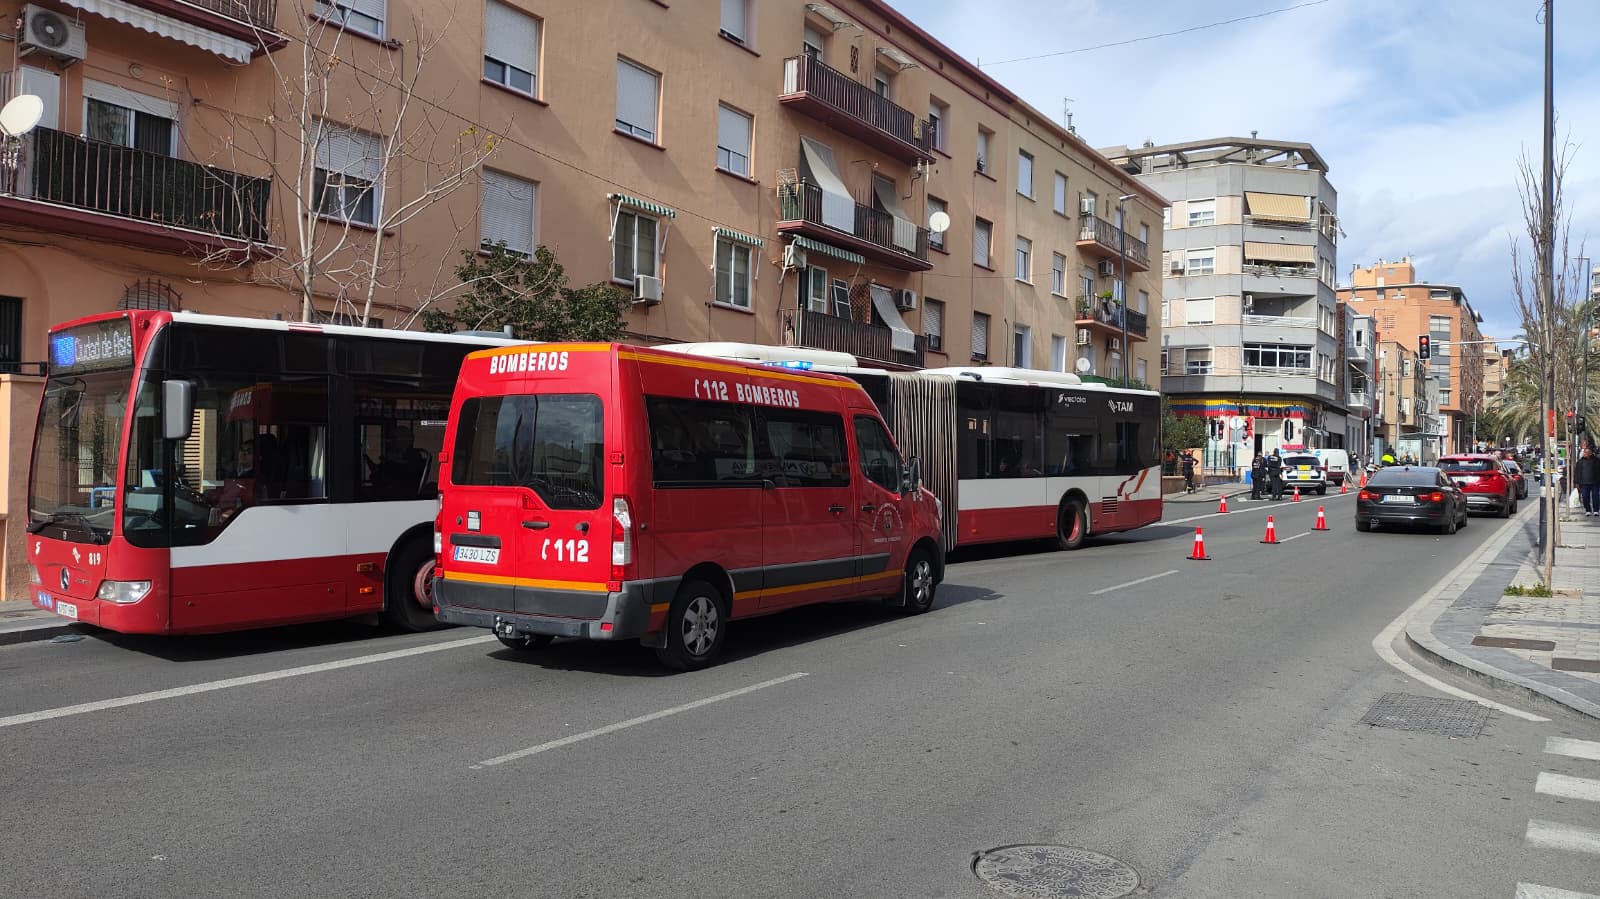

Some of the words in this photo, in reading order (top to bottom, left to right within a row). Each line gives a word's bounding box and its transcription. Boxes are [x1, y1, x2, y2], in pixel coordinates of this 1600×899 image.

[489, 351, 569, 375] BOMBEROS
[702, 379, 729, 401] 112
[735, 382, 800, 408] BOMBEROS
[1116, 401, 1134, 412] TAM
[88, 552, 101, 566] 819
[480, 549, 496, 562] LZS
[553, 538, 589, 563] 112
